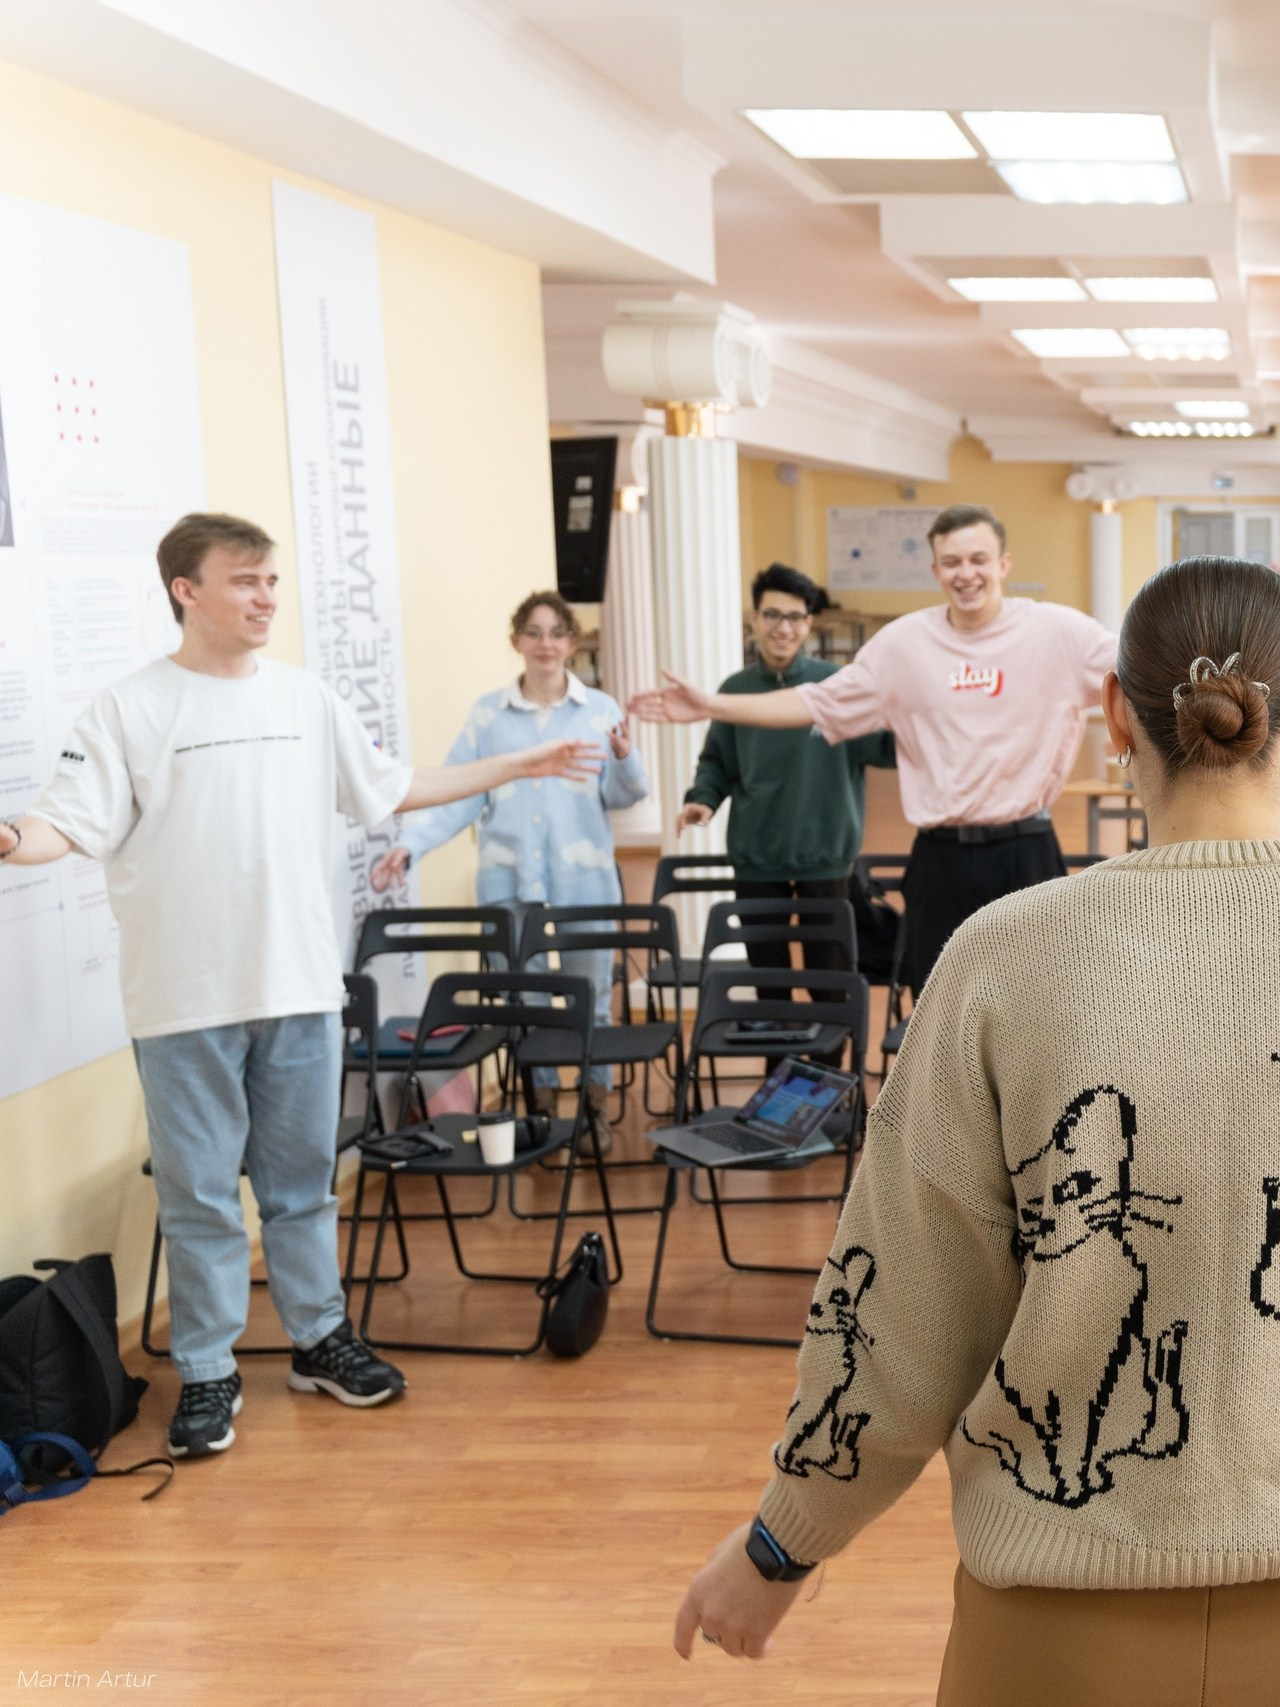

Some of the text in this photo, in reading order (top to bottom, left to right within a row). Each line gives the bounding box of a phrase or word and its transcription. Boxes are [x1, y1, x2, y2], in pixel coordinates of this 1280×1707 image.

[306, 459, 328, 629] ТЕХНОЛОГИИ
[333, 359, 380, 624] ДАННЫЕ
[947, 660, 1004, 697] slay
